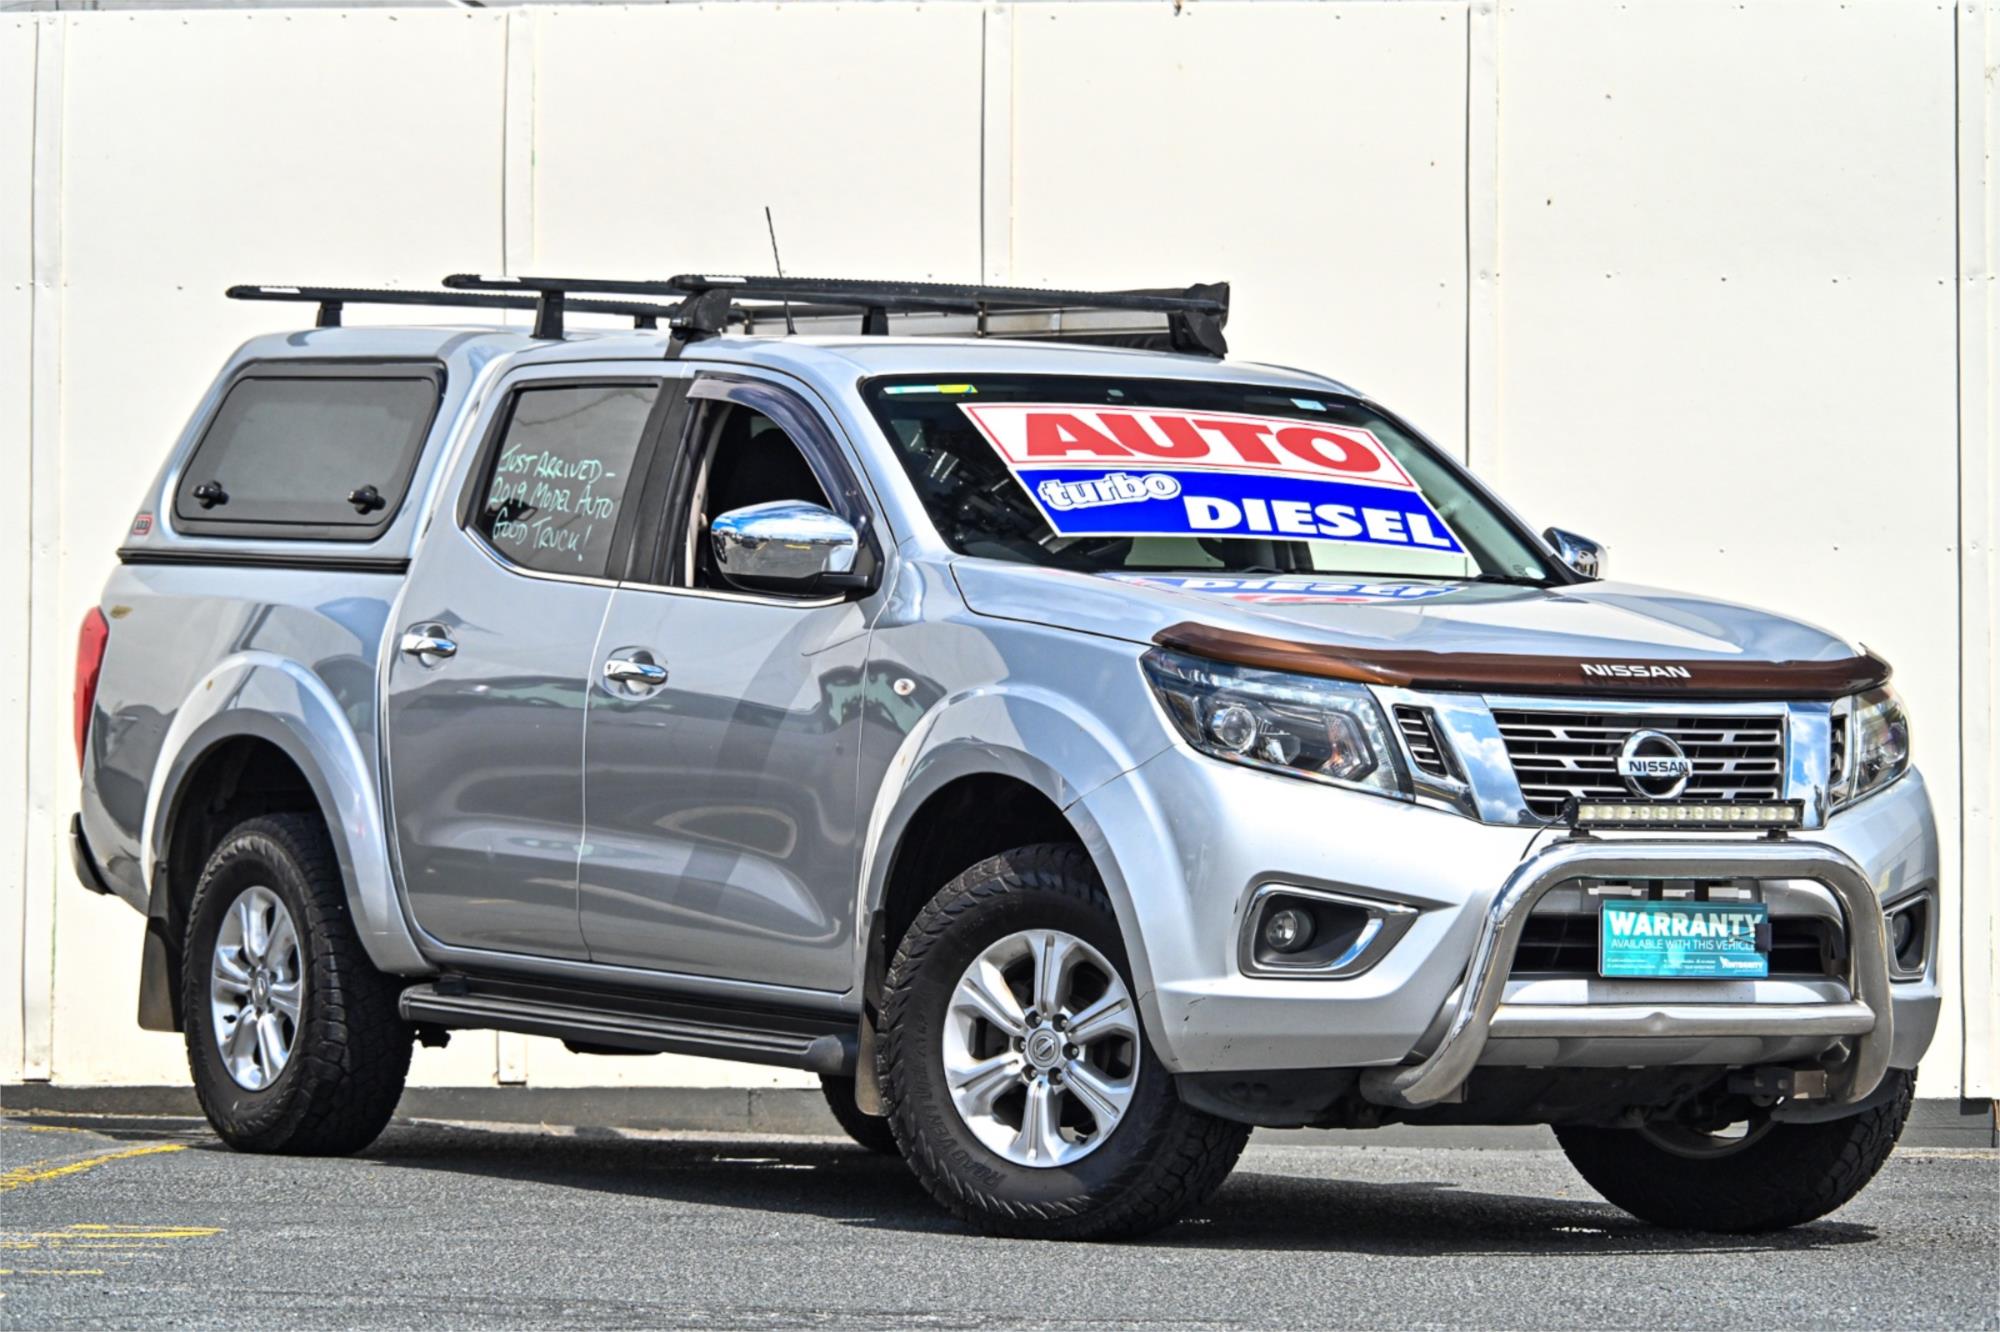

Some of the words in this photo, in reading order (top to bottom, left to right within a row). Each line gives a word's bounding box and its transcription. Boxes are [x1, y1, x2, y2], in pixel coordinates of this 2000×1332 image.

[1026, 413, 1381, 472] AUTO
[497, 443, 538, 474] JUST
[533, 451, 602, 483] ARRIVED
[486, 476, 527, 512] 2019
[529, 481, 570, 512] MODEL
[574, 484, 614, 519] AUTO
[1040, 473, 1180, 509] turbo
[492, 506, 528, 545] GOOD
[1183, 496, 1451, 548] DIESEL
[1580, 664, 1691, 678] NISSAN
[1629, 761, 1689, 774] NISSAN
[1609, 911, 1763, 938] WARRANTY
[1611, 938, 1663, 950] AVAILABLE
[1665, 939, 1690, 950] WITH
[1693, 939, 1714, 951] THIS
